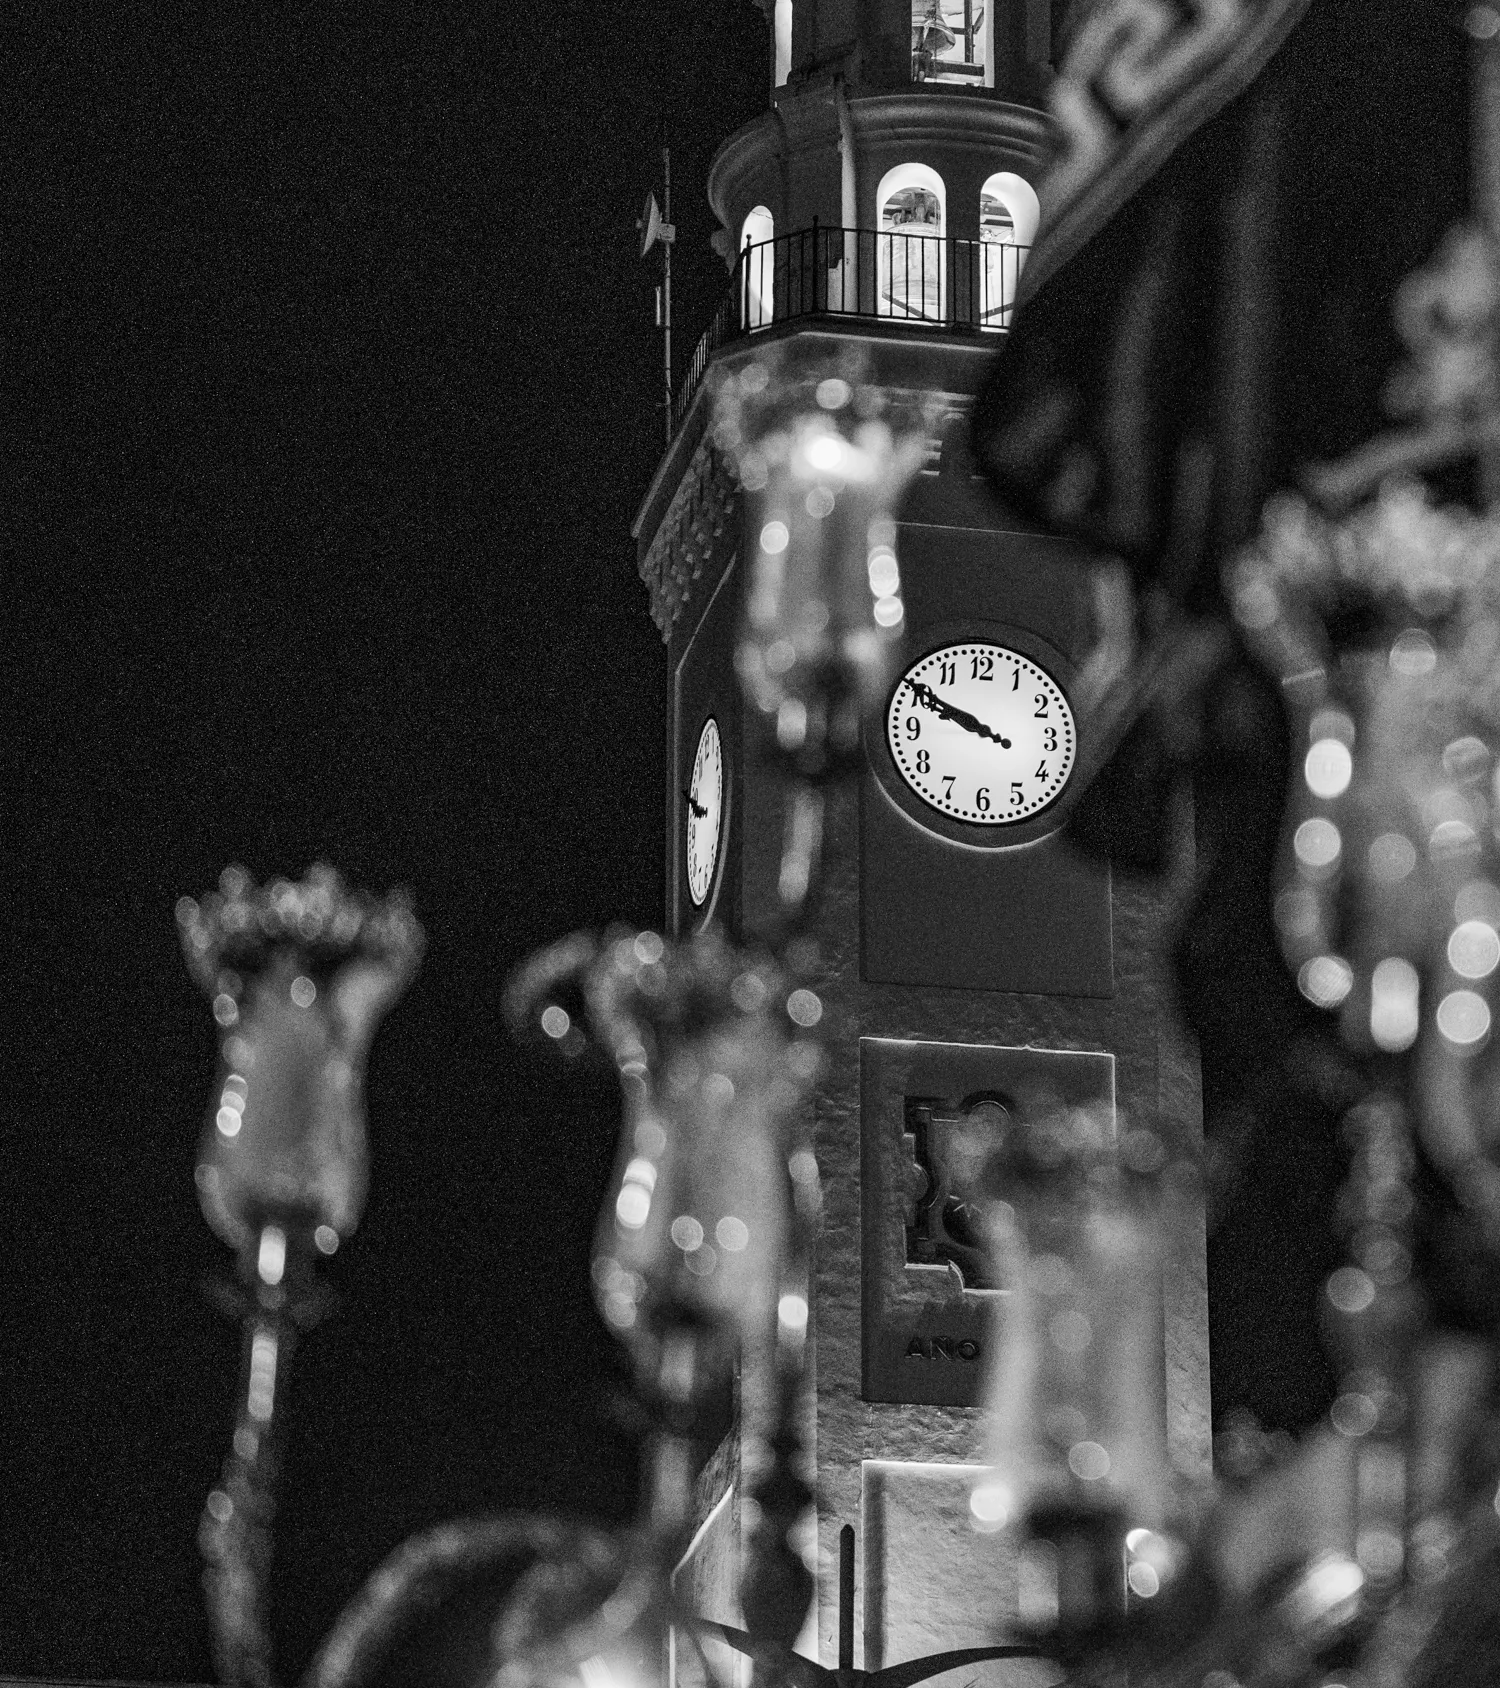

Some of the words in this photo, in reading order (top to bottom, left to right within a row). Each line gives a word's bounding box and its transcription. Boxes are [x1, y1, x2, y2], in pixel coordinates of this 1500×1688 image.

[940, 662, 956, 686] 11
[971, 656, 993, 681] 12
[1012, 668, 1020, 692] 1
[1034, 694, 1049, 719] 2
[905, 716, 920, 741] 9
[1044, 727, 1058, 751] 3
[916, 750, 930, 774] 8
[1034, 760, 1050, 783] 4
[942, 776, 956, 800] 7
[976, 788, 990, 812] 6
[1010, 782, 1025, 806] 5
